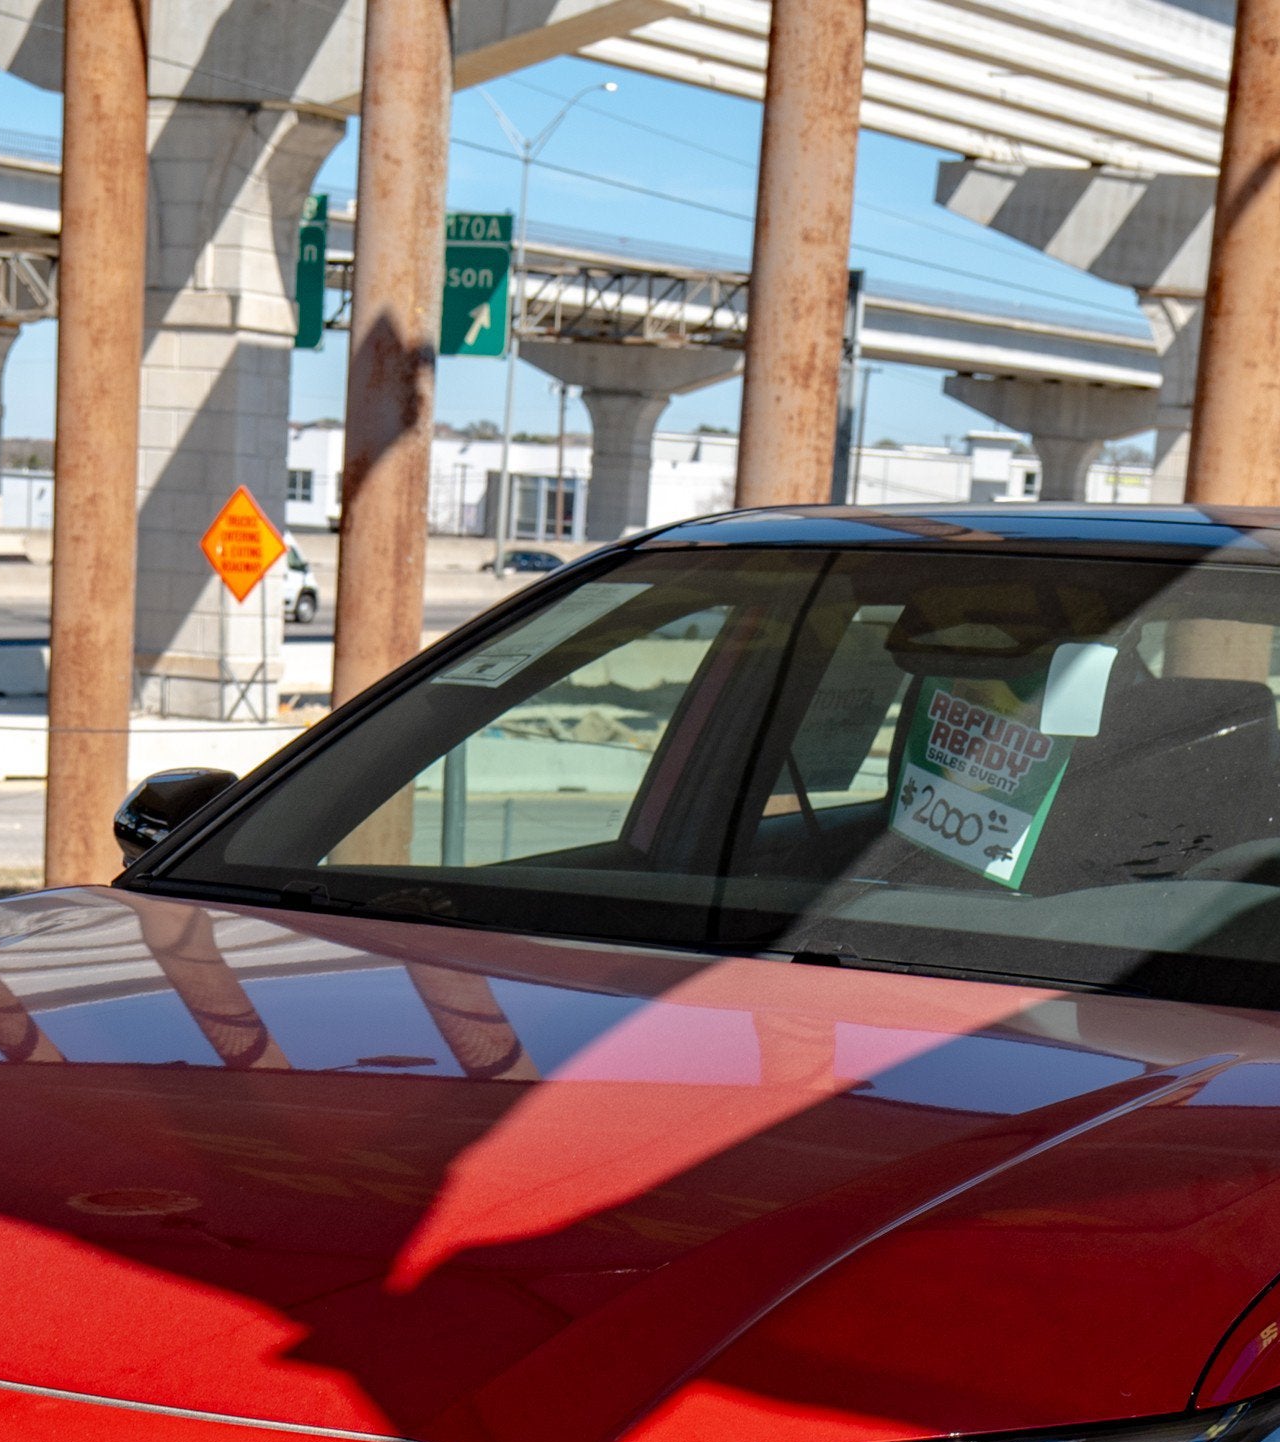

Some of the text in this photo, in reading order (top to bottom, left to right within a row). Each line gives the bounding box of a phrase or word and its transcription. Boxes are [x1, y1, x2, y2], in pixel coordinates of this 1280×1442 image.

[448, 267, 494, 288] son
[928, 749, 966, 772] SALES
[929, 722, 1030, 780] READY
[969, 766, 1018, 792] EVENT
